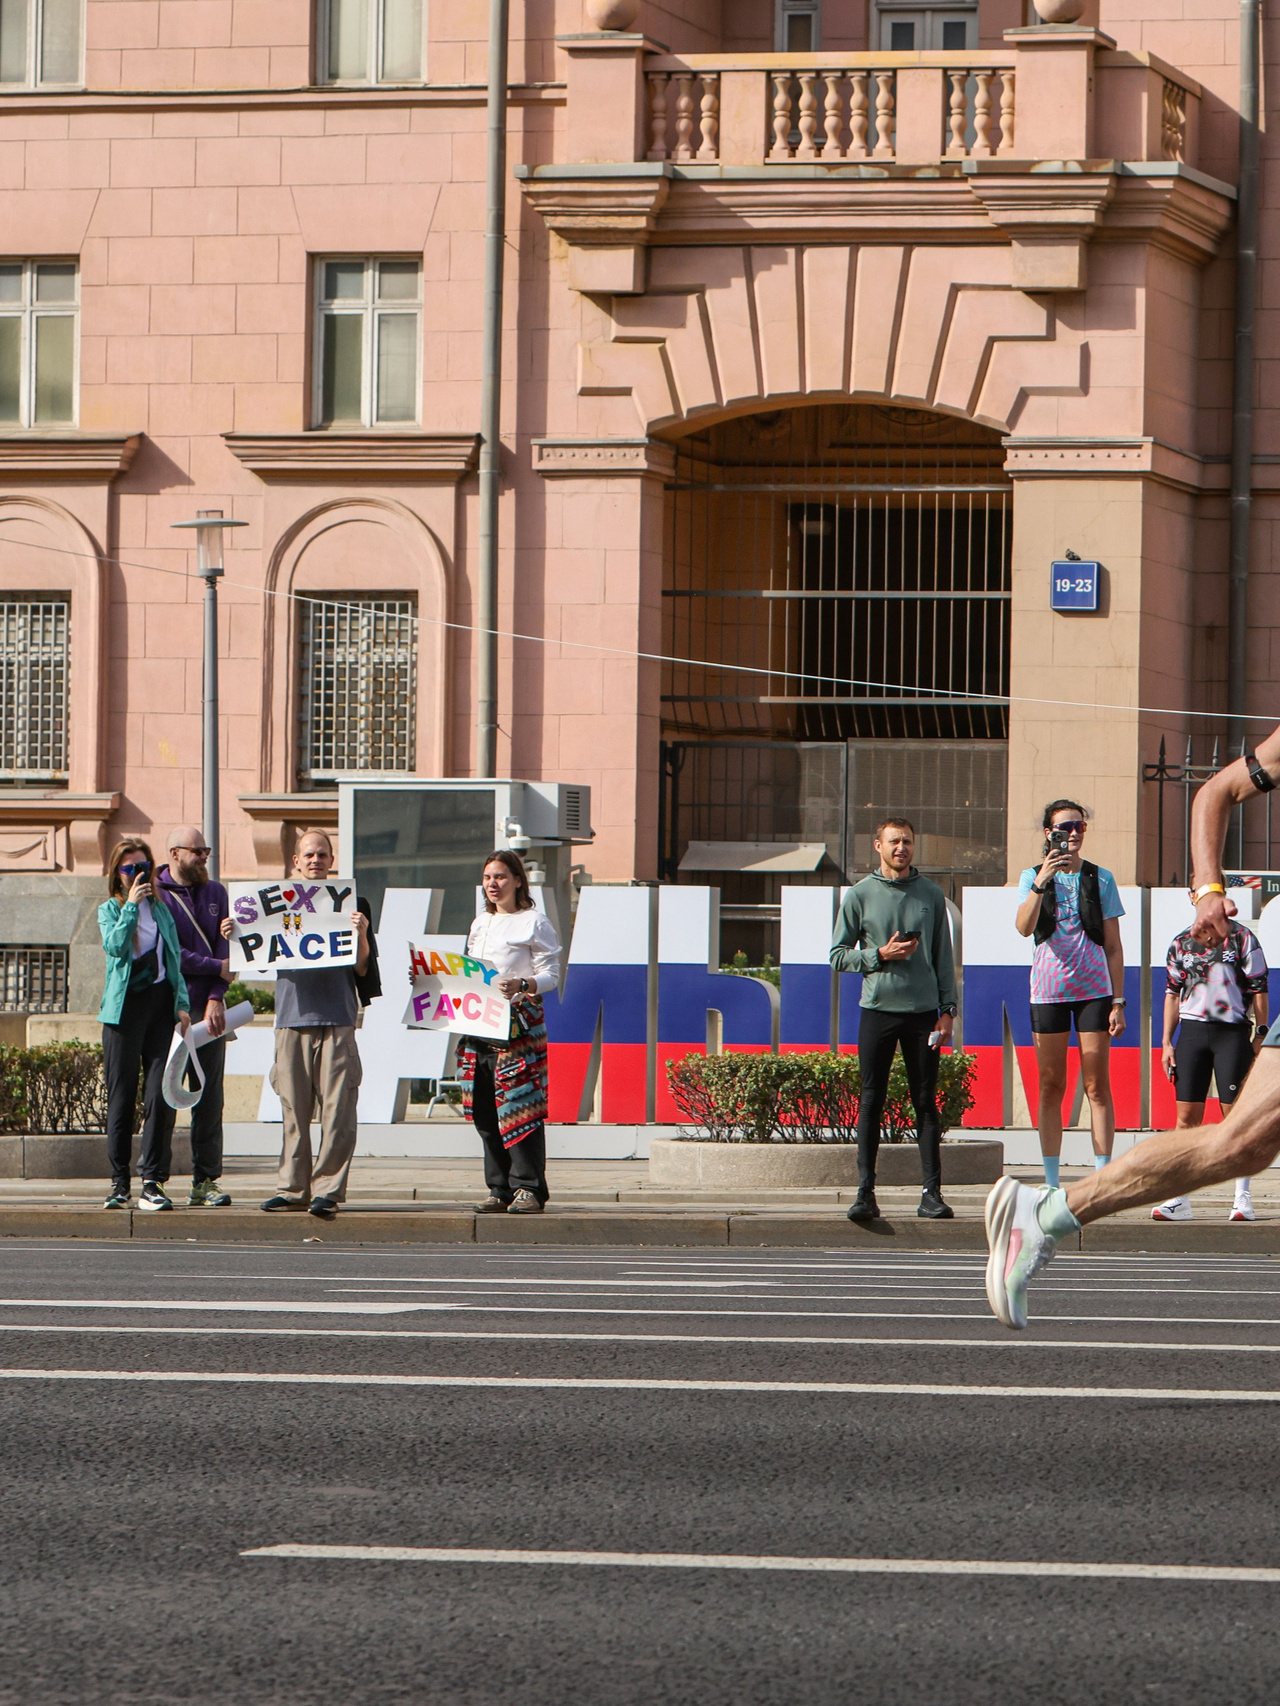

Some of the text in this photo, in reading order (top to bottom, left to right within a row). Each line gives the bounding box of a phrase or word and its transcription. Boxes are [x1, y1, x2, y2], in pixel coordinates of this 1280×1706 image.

[1055, 578, 1093, 593] 19-23
[233, 883, 352, 925] SEXY
[239, 930, 353, 964] PACE
[410, 948, 499, 986] HAPPY
[412, 991, 504, 1029] FACE
